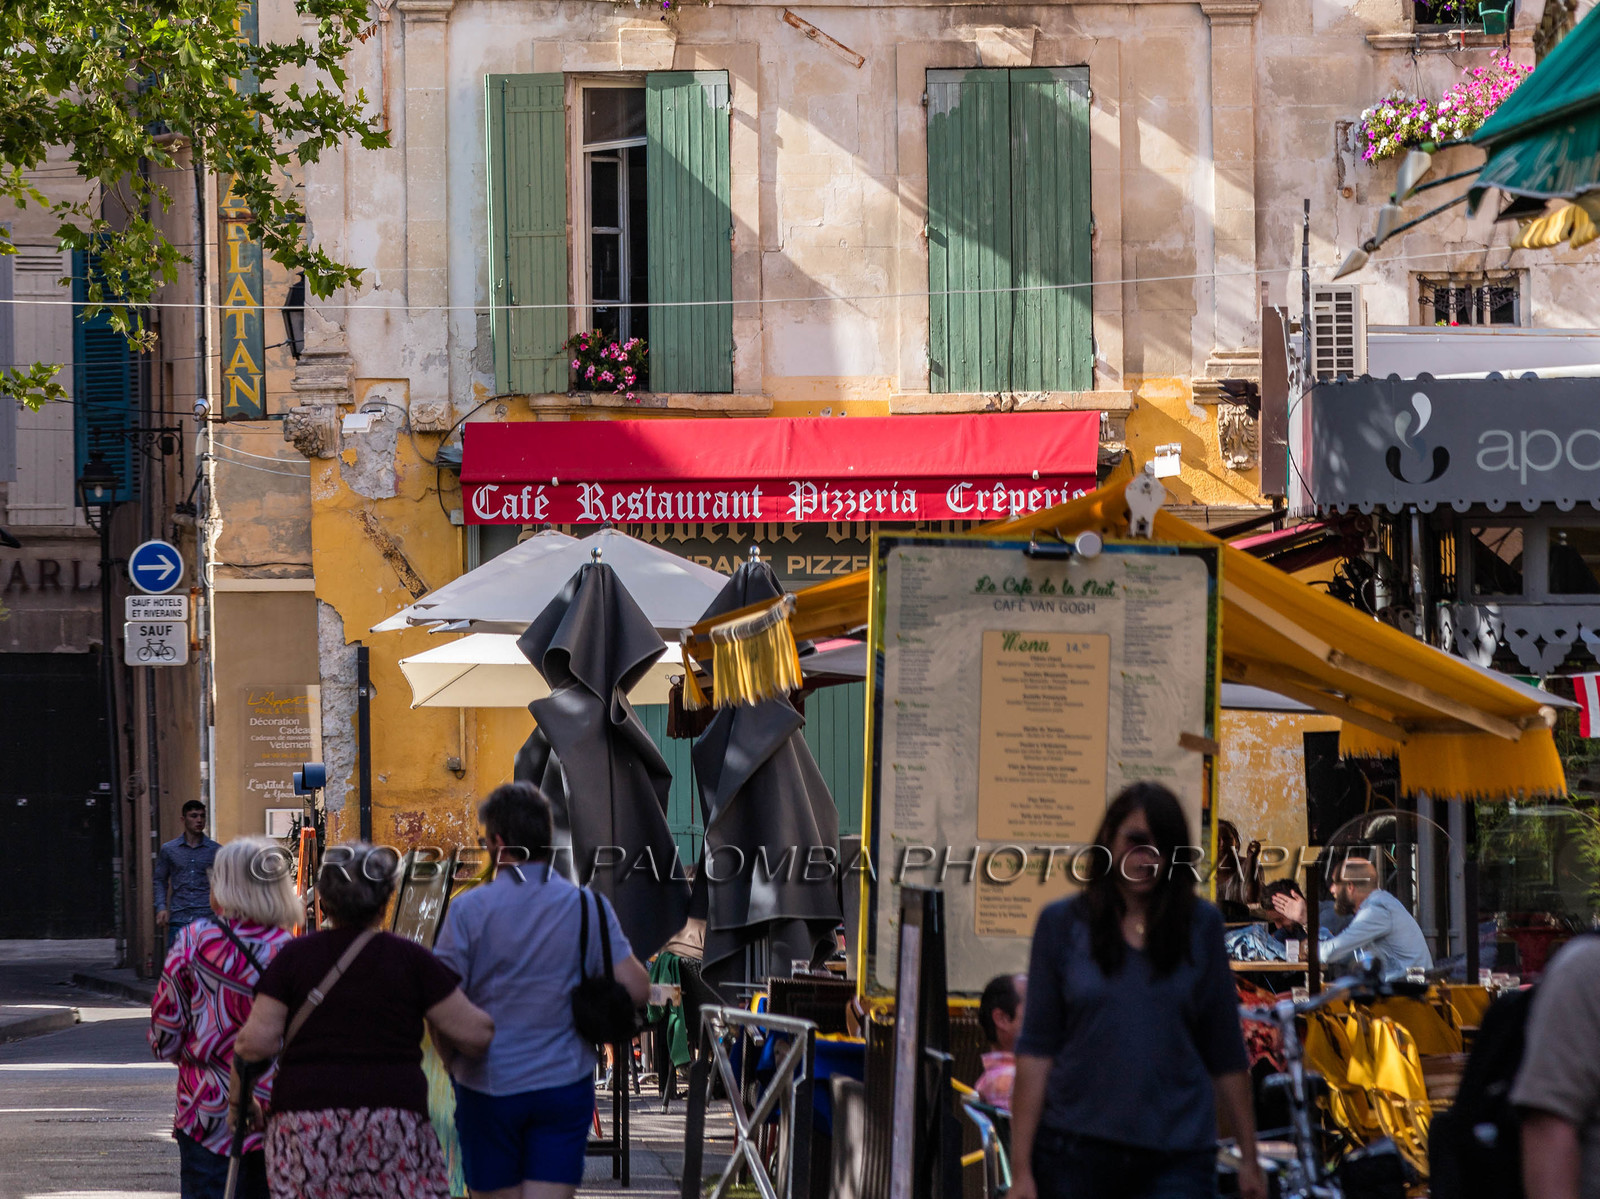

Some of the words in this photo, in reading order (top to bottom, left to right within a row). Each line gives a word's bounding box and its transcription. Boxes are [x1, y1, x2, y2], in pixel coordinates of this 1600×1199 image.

[471, 484, 550, 520] Café
[576, 482, 763, 521] Restaurant
[786, 481, 918, 520] Pizzeria
[1002, 575, 1034, 596] Café
[131, 598, 151, 607] SAUF
[153, 598, 183, 607] HOTELS
[993, 599, 1027, 612] CAFÉ
[1030, 601, 1056, 613] VAN
[1059, 602, 1096, 614] GOGH
[131, 609, 142, 618] ET
[144, 609, 183, 618] RIVERAINS
[139, 625, 174, 637] SAUF
[1002, 630, 1050, 652] Menu
[249, 716, 300, 726] Décoration
